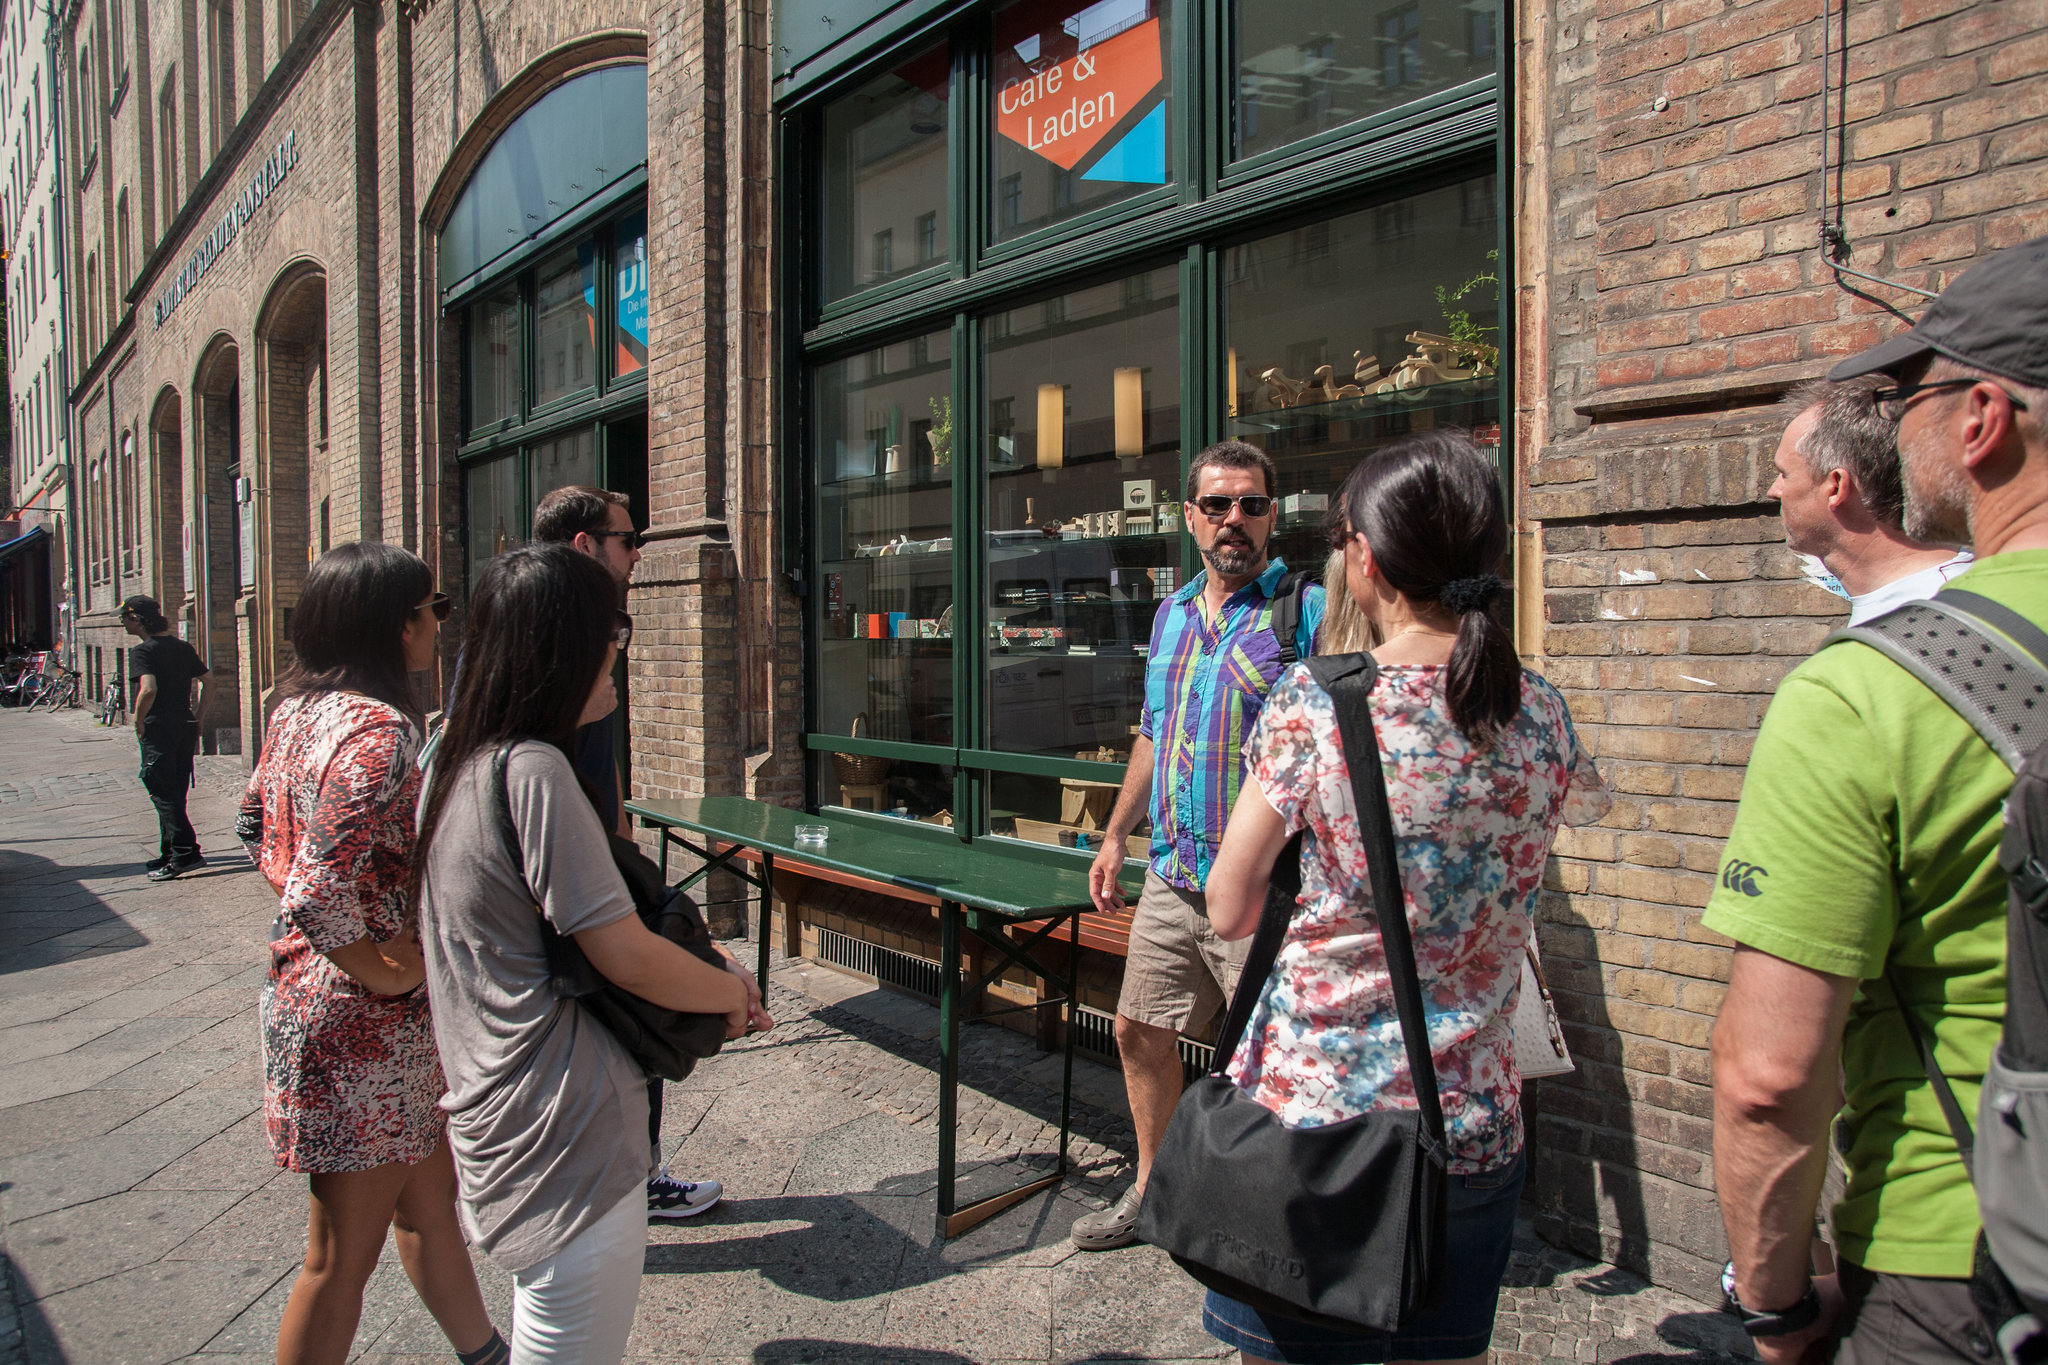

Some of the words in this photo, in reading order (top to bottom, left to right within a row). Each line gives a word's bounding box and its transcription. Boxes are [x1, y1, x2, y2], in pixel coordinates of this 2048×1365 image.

[1001, 56, 1062, 115] Café
[1072, 51, 1096, 82] &
[1027, 91, 1115, 151] Laden
[627, 299, 639, 314] Die
